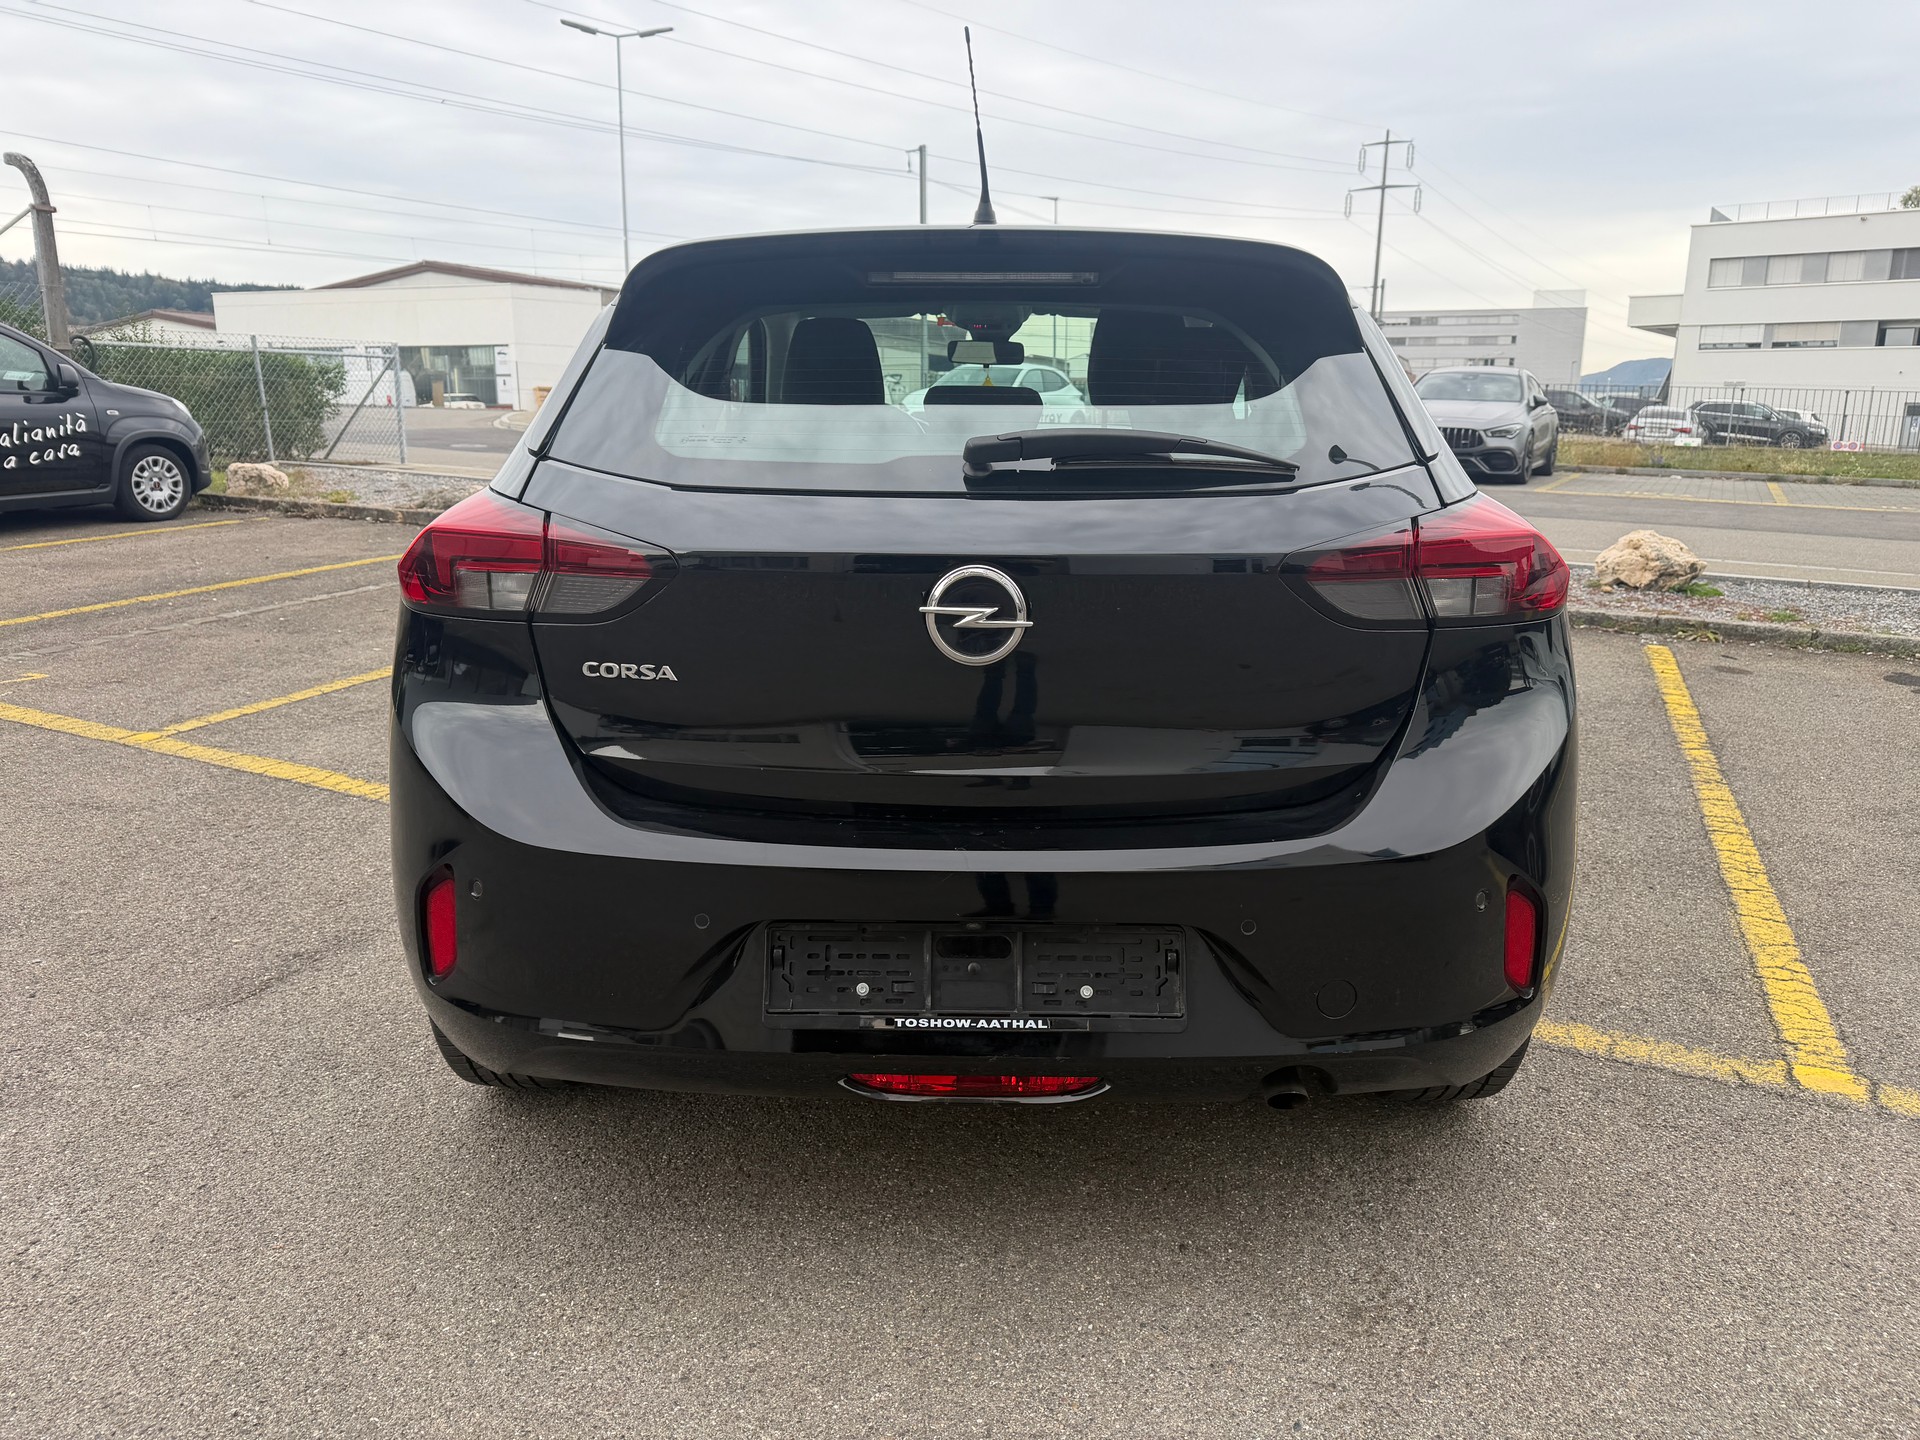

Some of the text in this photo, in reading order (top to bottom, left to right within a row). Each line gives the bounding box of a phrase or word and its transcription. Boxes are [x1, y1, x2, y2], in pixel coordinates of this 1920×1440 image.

[3, 443, 81, 469] a casa
[582, 661, 678, 681] CORSA
[894, 1018, 1048, 1029] TOSHOW-AATHAL
